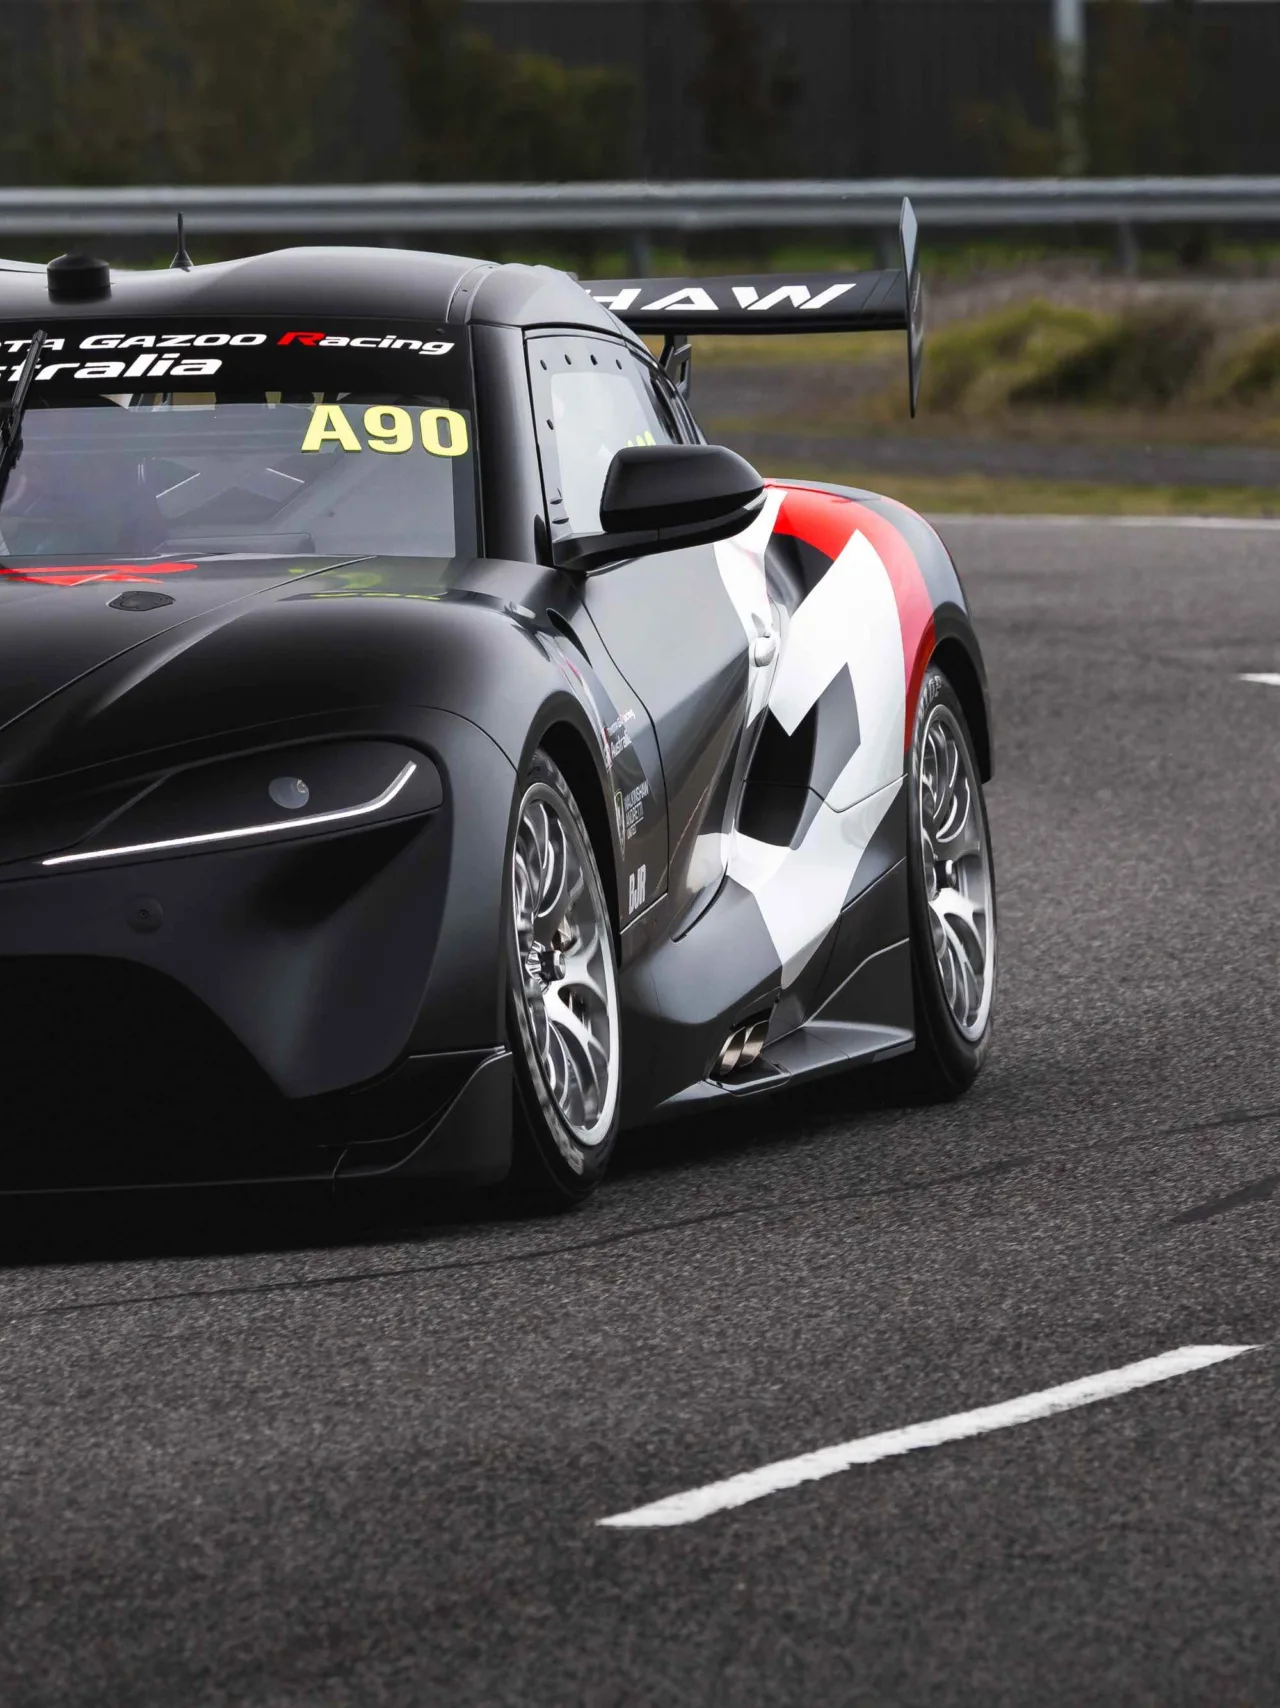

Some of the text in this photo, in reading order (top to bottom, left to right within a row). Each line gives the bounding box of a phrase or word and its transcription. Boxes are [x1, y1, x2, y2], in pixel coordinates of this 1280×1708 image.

[79, 333, 267, 350] GAZOO
[276, 331, 455, 356] Racing
[301, 404, 469, 457] A90
